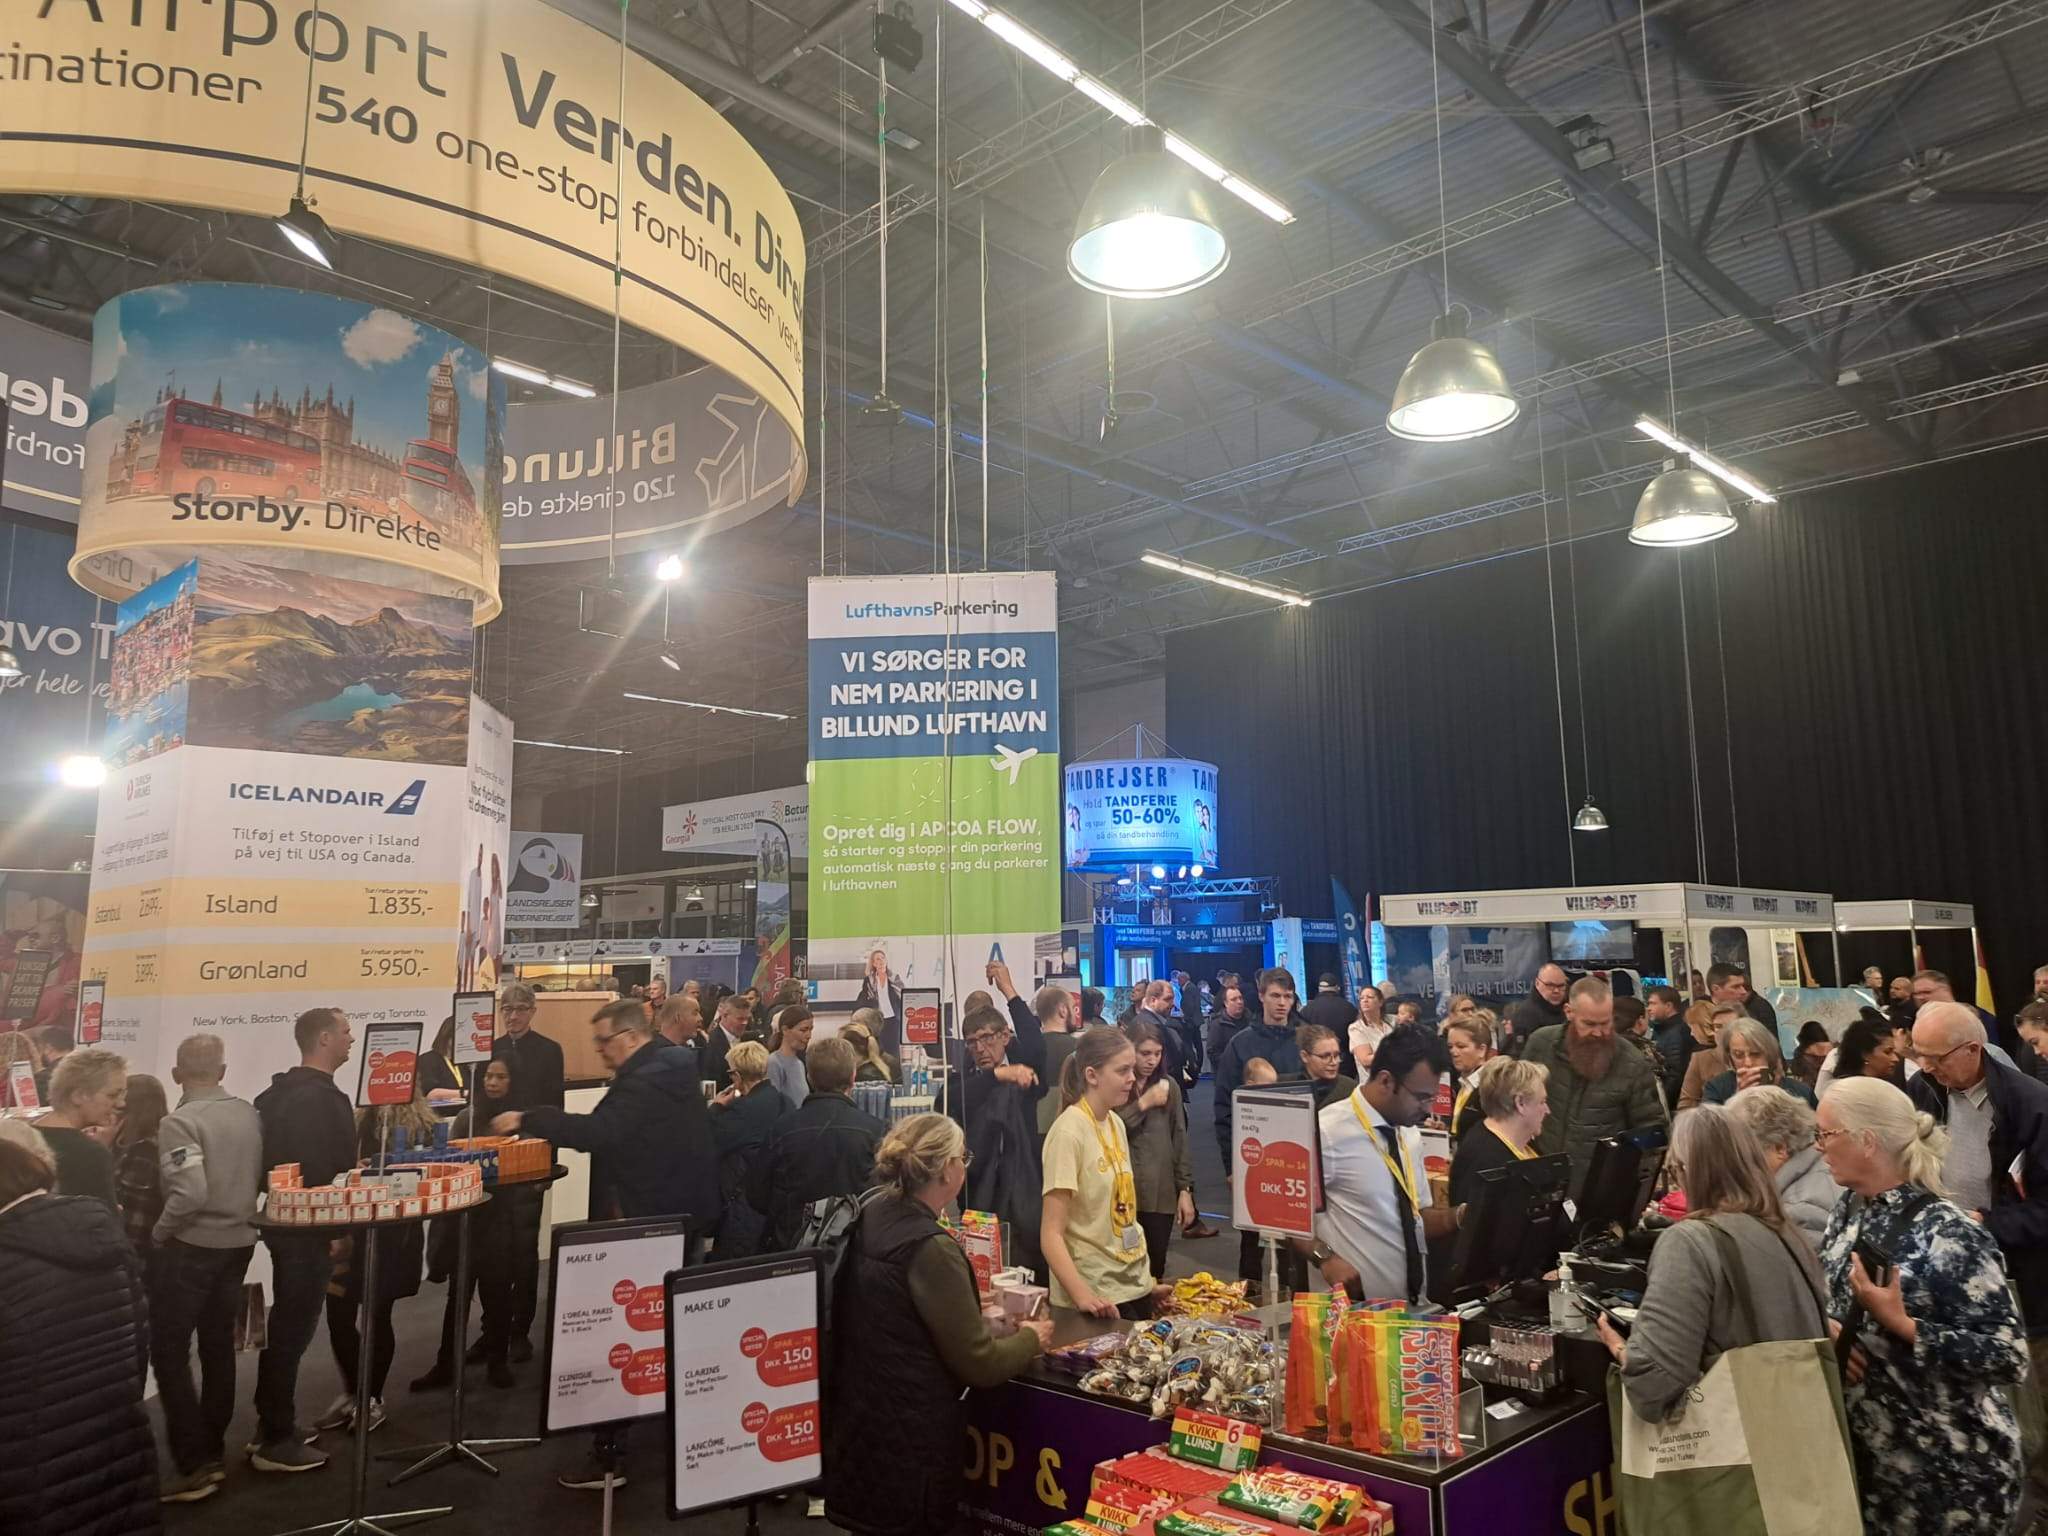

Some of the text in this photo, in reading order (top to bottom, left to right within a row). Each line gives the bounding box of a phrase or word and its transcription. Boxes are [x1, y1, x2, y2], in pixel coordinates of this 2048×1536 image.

[501, 51, 741, 247] Verden.
[0, 42, 774, 324] inationer 540 one-stop forbindelser
[172, 493, 441, 550] Storby. Direkte
[846, 599, 1018, 618] LufthavnsParkering
[840, 647, 1026, 673] VI SØRGER FOR
[36, 669, 84, 694] hele
[831, 679, 1037, 706] NEM PARKERING I
[821, 710, 1047, 738] BILLUND LUFTHAVN
[229, 782, 384, 808] ICELANDAIR
[1083, 795, 1178, 809] Hold TANDFERIE
[1112, 808, 1181, 825] 50-60%
[232, 827, 420, 847] Tilføj et Stopover i Island
[822, 824, 874, 844] Opret
[879, 822, 905, 841] dig
[920, 820, 982, 838] APCOA
[234, 847, 415, 864] på vej til USA og Canada.
[823, 840, 1042, 858] så starter og din parkering
[822, 862, 893, 875] automatisk
[897, 861, 936, 872] næste
[975, 858, 990, 870] du
[994, 858, 1049, 871] parkerer
[830, 878, 897, 891] lufthavnen
[205, 894, 434, 916] Island 1.835,-
[1176, 928, 1208, 940] 50-60%
[199, 958, 429, 981] Grønland 5.950,-
[1417, 982, 1490, 998] VEOMMEN
[193, 1016, 218, 1027] New
[251, 1013, 291, 1025] Boston,
[373, 1011, 387, 1021] og
[388, 1008, 428, 1018] Toronto.
[920, 1021, 937, 1030] 150
[387, 1071, 412, 1084] 100
[1265, 1157, 1306, 1170] SPAR 14
[1260, 1178, 1306, 1198] DKK 35
[566, 1252, 607, 1264] MAKE UP
[592, 1306, 614, 1317] PARIS
[684, 1298, 731, 1314] MAKE UP
[764, 1347, 812, 1369] DKK 150
[559, 1371, 592, 1382] CLINIQUE
[685, 1365, 721, 1379] CLARINS
[1400, 1328, 1446, 1454] TONY'S
[743, 1409, 766, 1418] SPECIAL
[745, 1417, 764, 1427] OFFER
[775, 1414, 795, 1424] SPAR
[766, 1421, 814, 1443] DKK 150
[1187, 1423, 1240, 1443] KVIKK 6
[685, 1437, 725, 1453] LANCÔME
[1184, 1435, 1217, 1452] LUNSJ
[1036, 1447, 1068, 1510] &
[1297, 1489, 1312, 1501] 6
[1100, 1505, 1129, 1525] KVIKK
